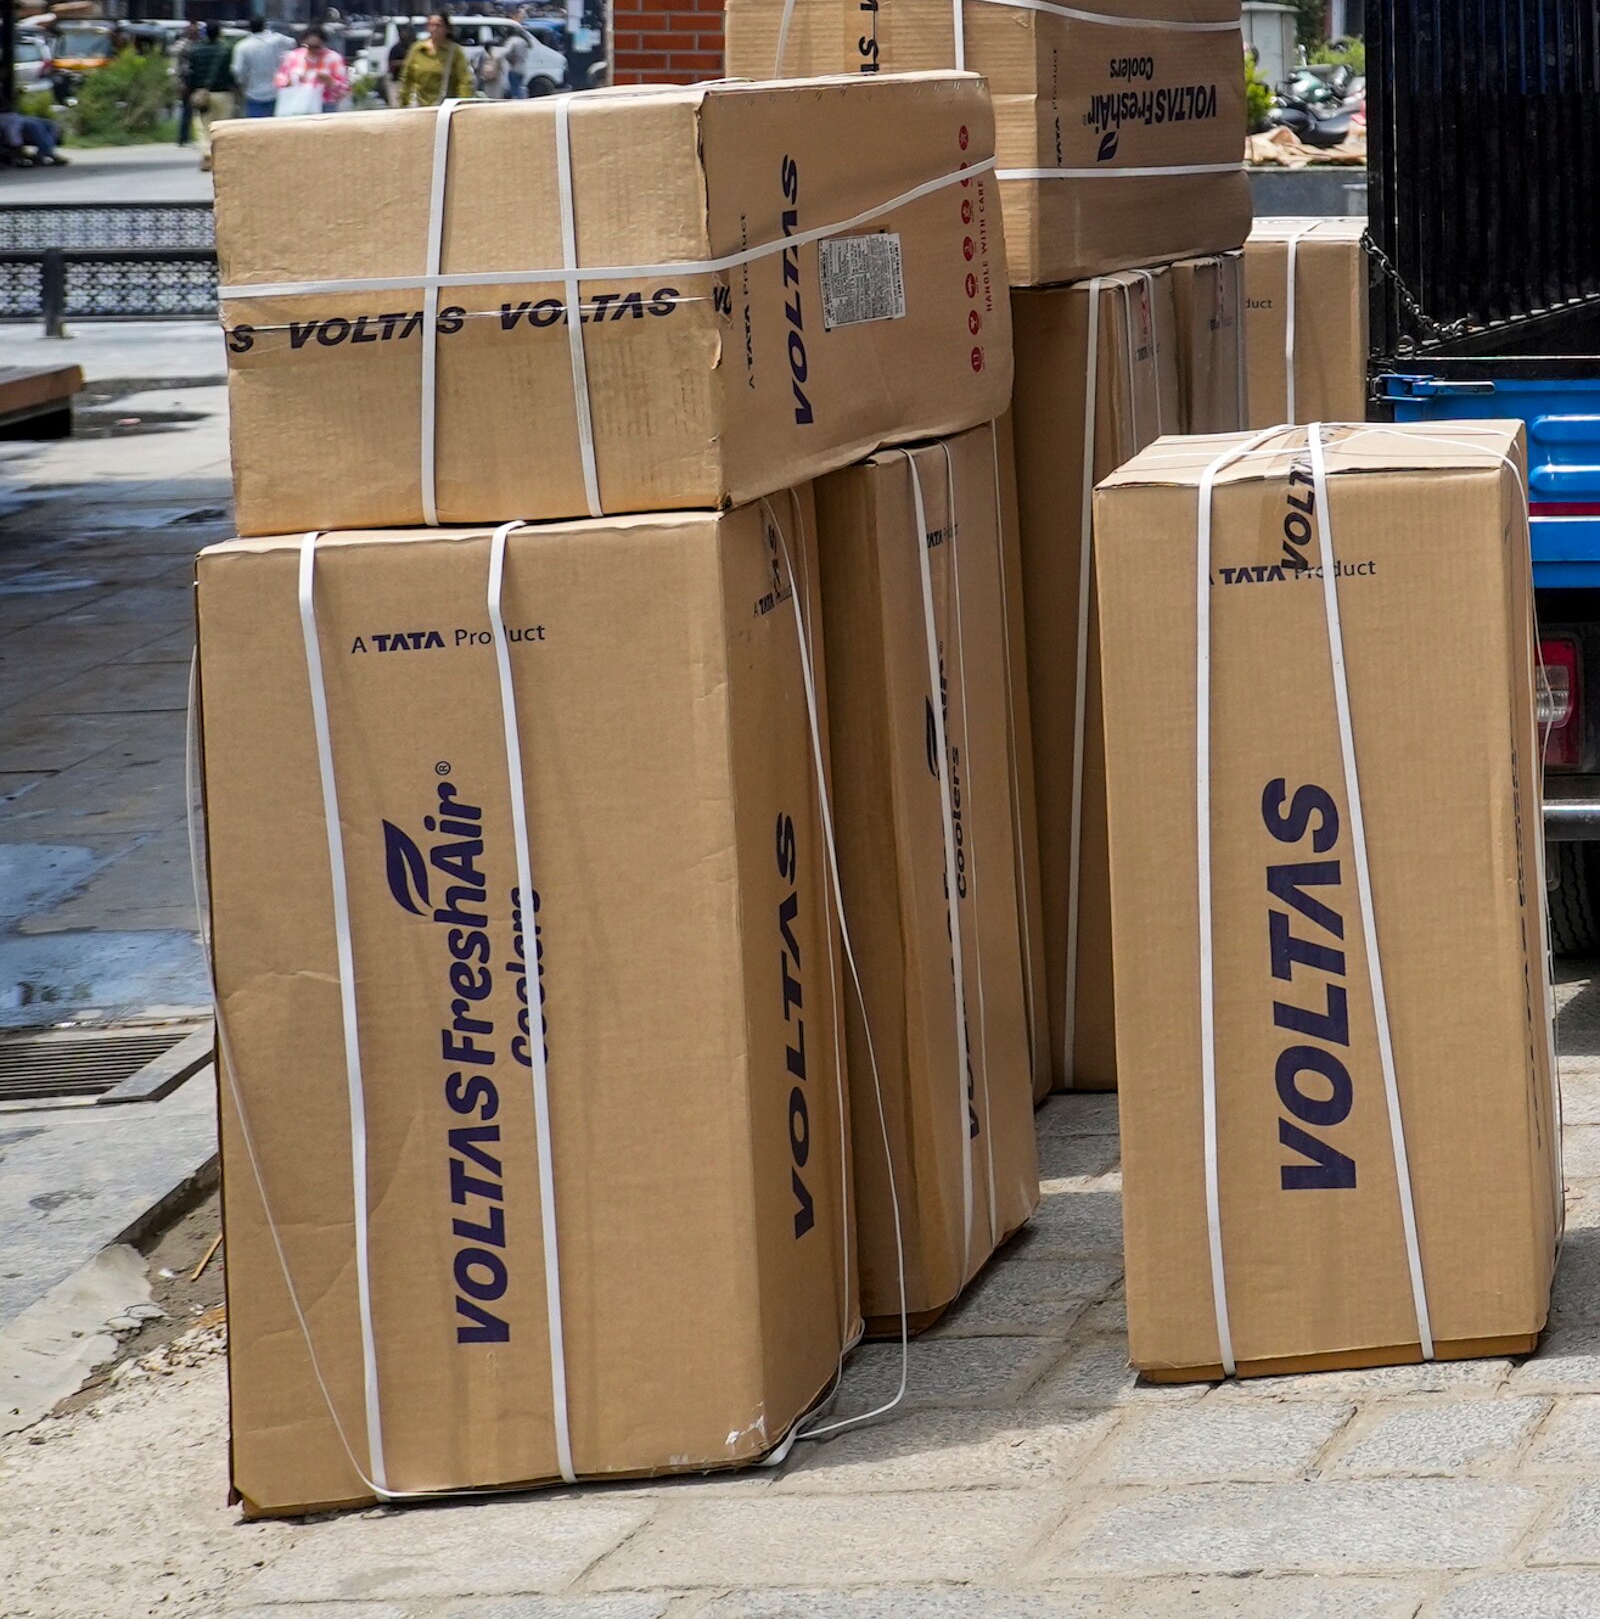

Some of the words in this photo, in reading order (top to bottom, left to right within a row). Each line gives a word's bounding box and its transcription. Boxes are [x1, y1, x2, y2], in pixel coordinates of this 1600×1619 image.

[1110, 56, 1154, 83] Coolers
[781, 154, 814, 425] VOLTAS
[1245, 298, 1273, 310] duct
[1218, 564, 1287, 586] TATA
[351, 636, 368, 654] A
[371, 630, 446, 652] TATA
[953, 745, 968, 899] Coolers
[776, 809, 817, 1239] VOLTAS
[1261, 777, 1358, 1190] VOLTAS
